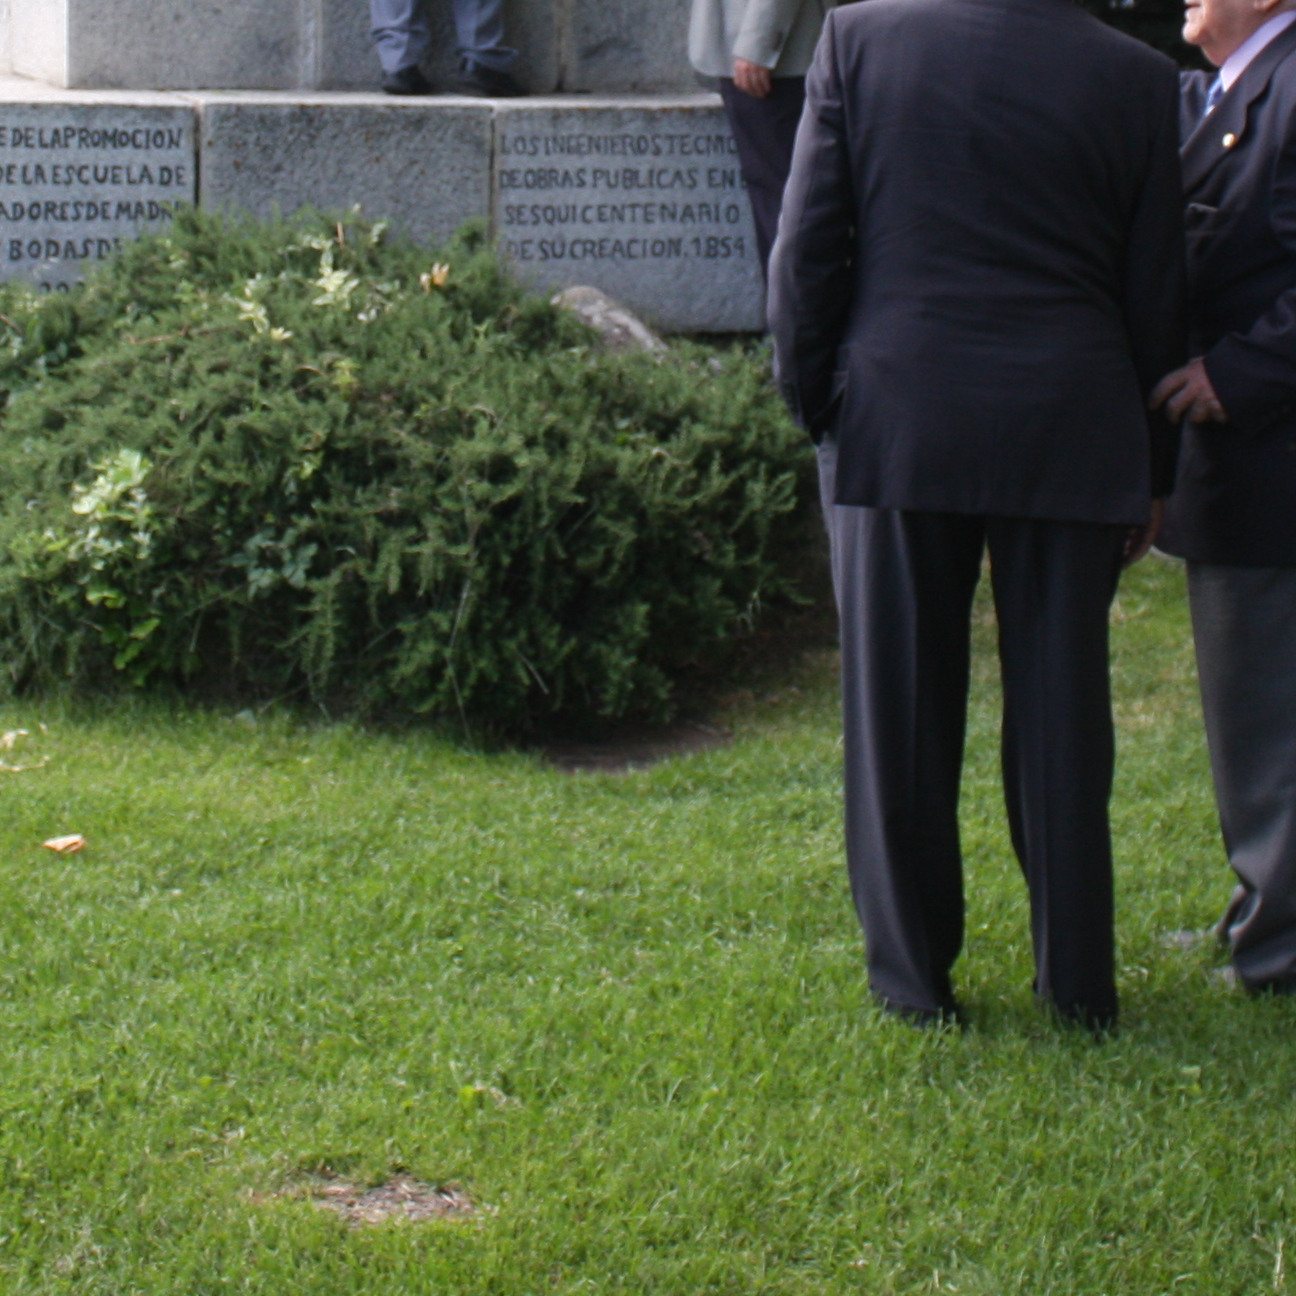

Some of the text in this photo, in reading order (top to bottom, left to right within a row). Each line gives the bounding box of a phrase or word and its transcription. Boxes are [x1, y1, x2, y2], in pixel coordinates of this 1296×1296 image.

[12, 128, 35, 148] DE
[38, 128, 65, 149] LA
[65, 127, 183, 150] PROMOCION
[500, 134, 540, 155] LOS
[544, 134, 662, 156] INGENIEROS
[21, 165, 47, 186] LA
[53, 164, 154, 186] ESCUELA
[159, 165, 186, 187] DE
[499, 169, 523, 189] DE
[524, 168, 587, 190] OBRAS
[593, 168, 697, 190] PUBLICAS
[708, 168, 735, 190] EN
[86, 201, 110, 221] DE
[504, 203, 741, 226] SESQUICENTENARIO
[8, 238, 94, 261] BODAS
[506, 239, 534, 260] DE
[538, 238, 565, 261] SU
[691, 236, 745, 259] 1854
